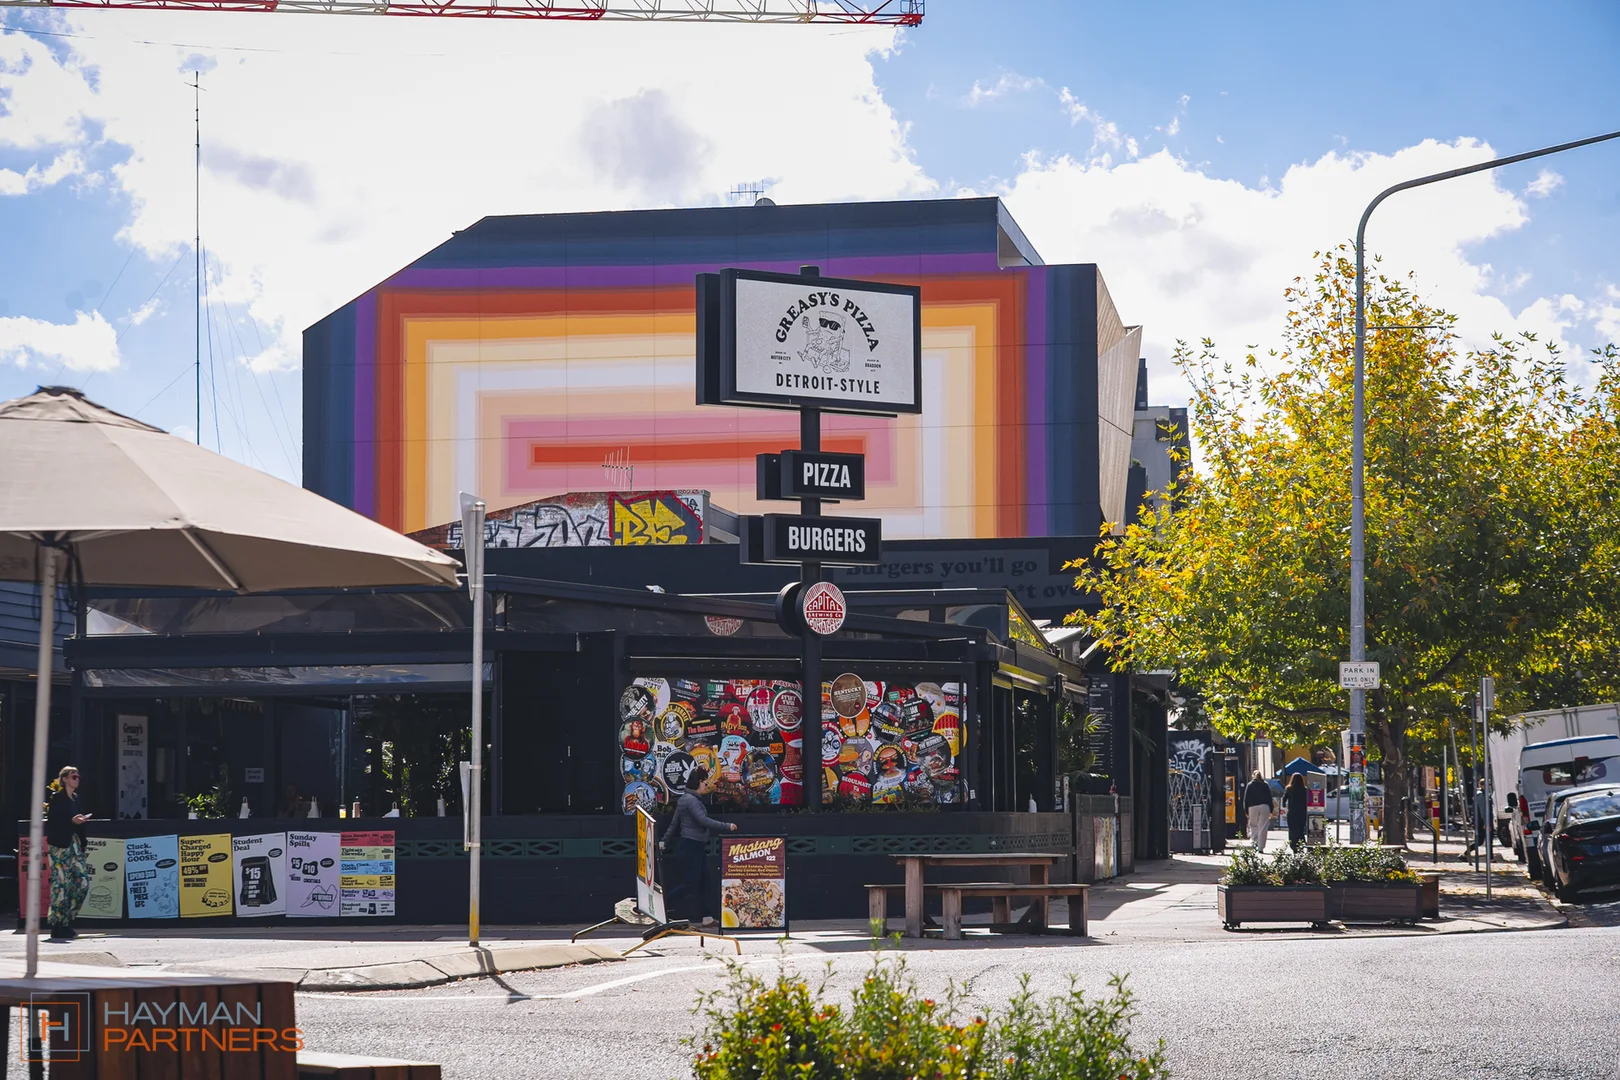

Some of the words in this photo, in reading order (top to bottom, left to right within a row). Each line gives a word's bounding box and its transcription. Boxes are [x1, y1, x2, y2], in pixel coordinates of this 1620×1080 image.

[776, 292, 840, 342] GREASY'S
[842, 298, 879, 352] PIZZA
[776, 373, 880, 394] DETROIT-STYLE
[804, 462, 851, 488] PIZZA
[788, 526, 866, 552] BURGERS
[940, 558, 1004, 577] you'll
[1011, 560, 1037, 576] go
[808, 592, 841, 610] CAPITAL
[290, 834, 317, 842] Sunday
[728, 838, 783, 856] Mustang
[733, 848, 770, 863] SALMON
[246, 868, 260, 879] $15
[305, 865, 314, 874] $10
